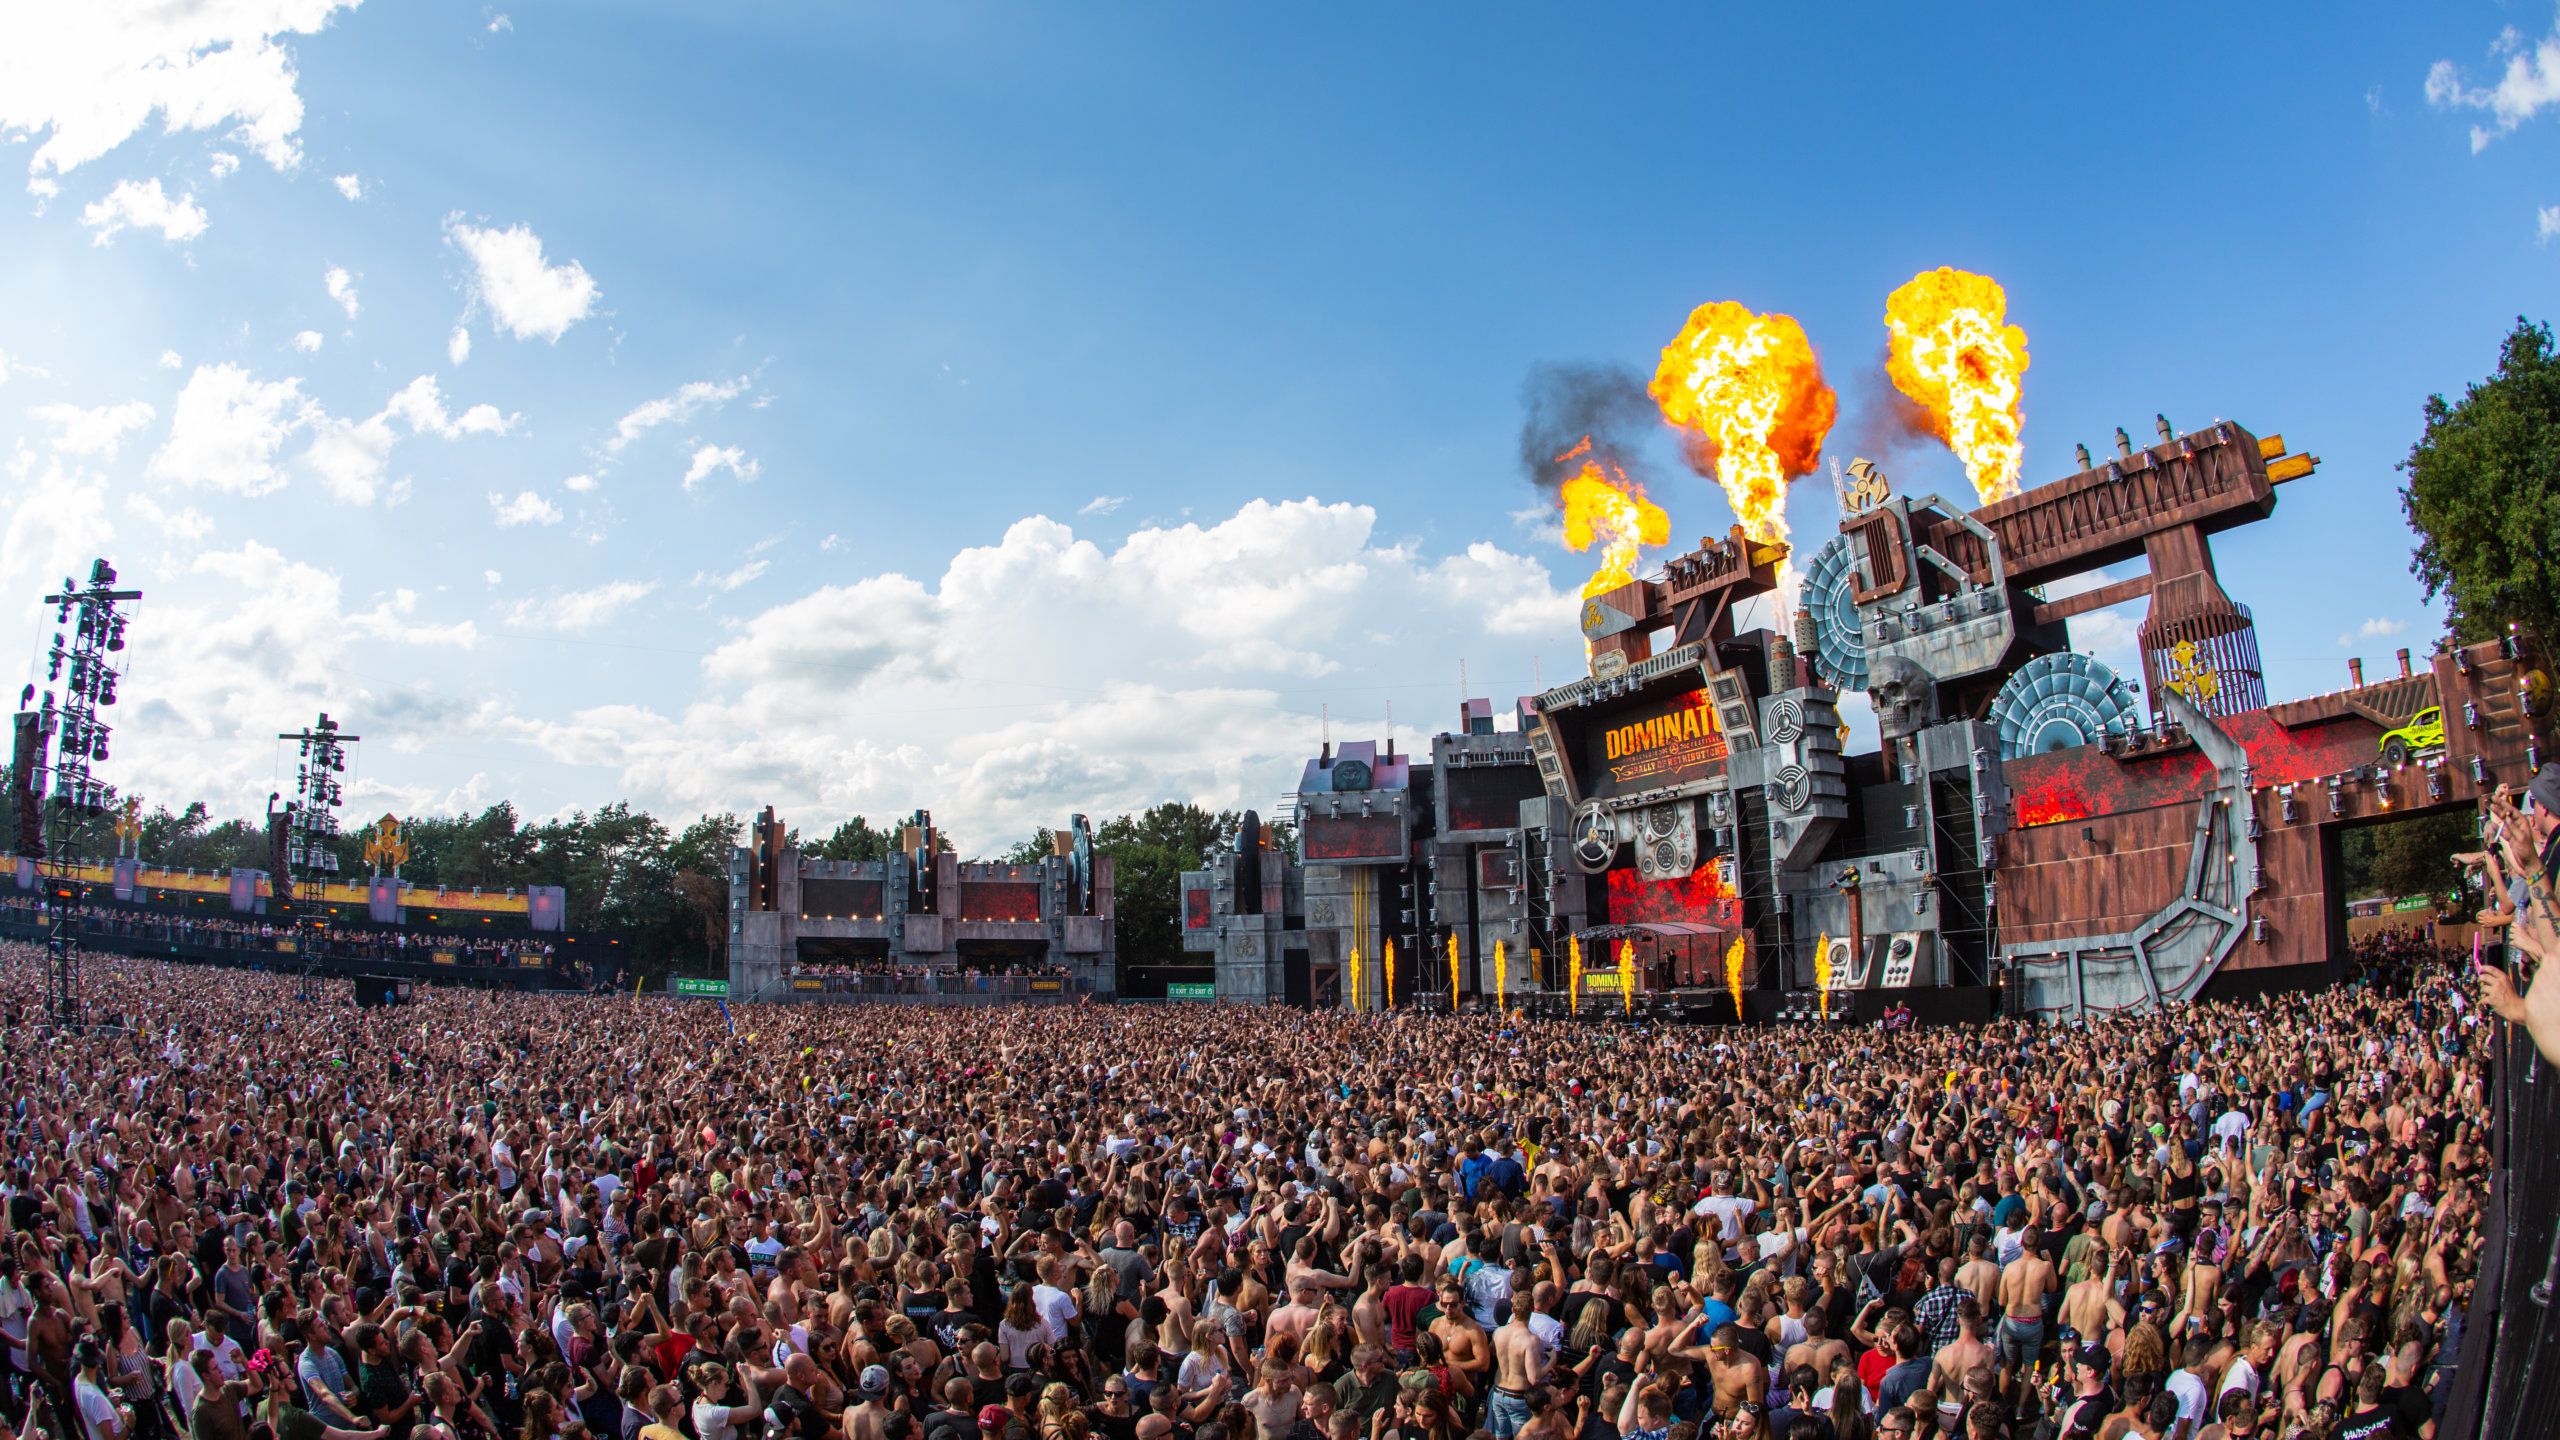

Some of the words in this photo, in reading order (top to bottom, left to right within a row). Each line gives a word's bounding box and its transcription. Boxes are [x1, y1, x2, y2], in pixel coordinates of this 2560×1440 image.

[1605, 704, 1722, 760] DOMINATO
[685, 983, 697, 991] EXIT
[706, 984, 718, 992] EXIT
[1586, 974, 1635, 988] DOMINATR
